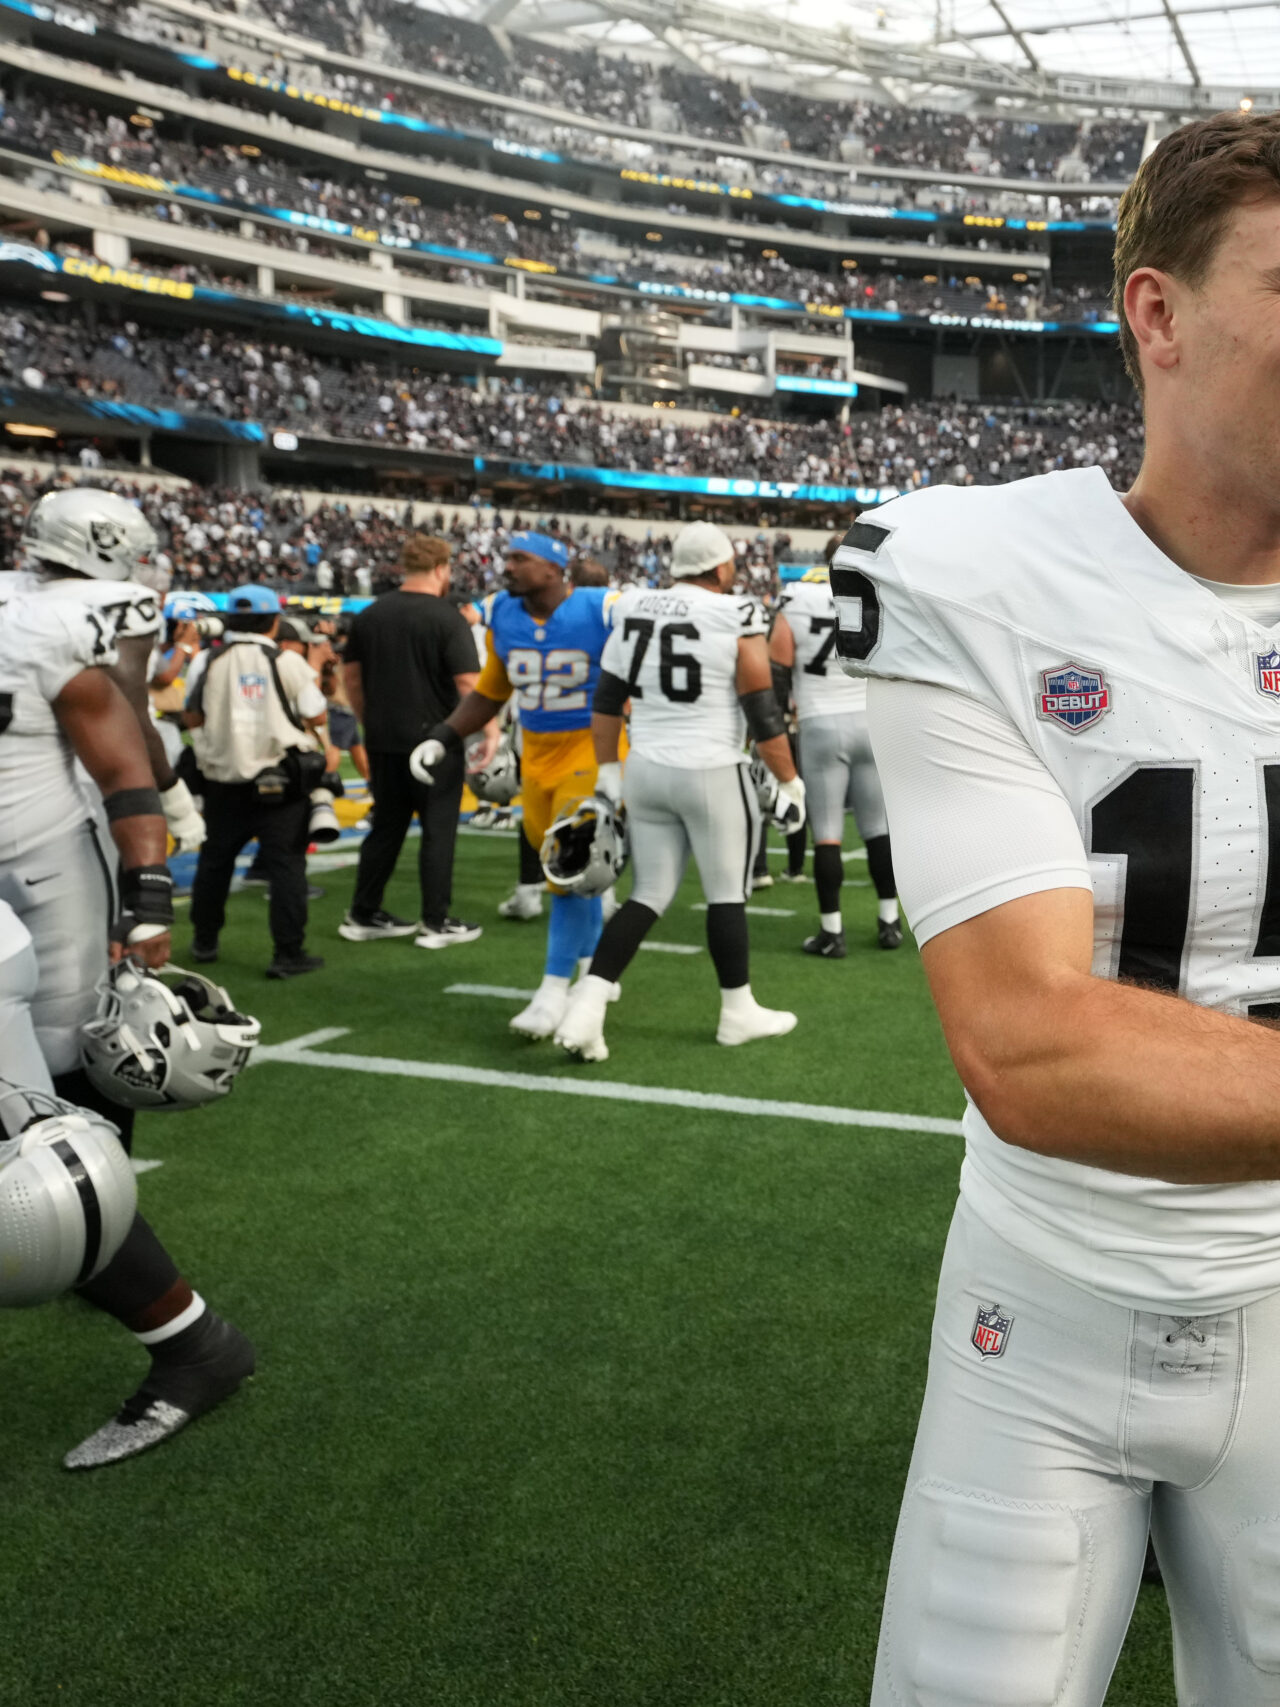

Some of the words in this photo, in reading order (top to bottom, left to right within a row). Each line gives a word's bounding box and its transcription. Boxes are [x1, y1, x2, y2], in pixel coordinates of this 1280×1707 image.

[63, 257, 194, 299] CHARGERS
[707, 478, 799, 499] BOLT
[622, 617, 702, 703] 76
[507, 649, 591, 712] 92
[1045, 692, 1105, 711] DEBUT
[975, 1325, 1000, 1351] NFL
